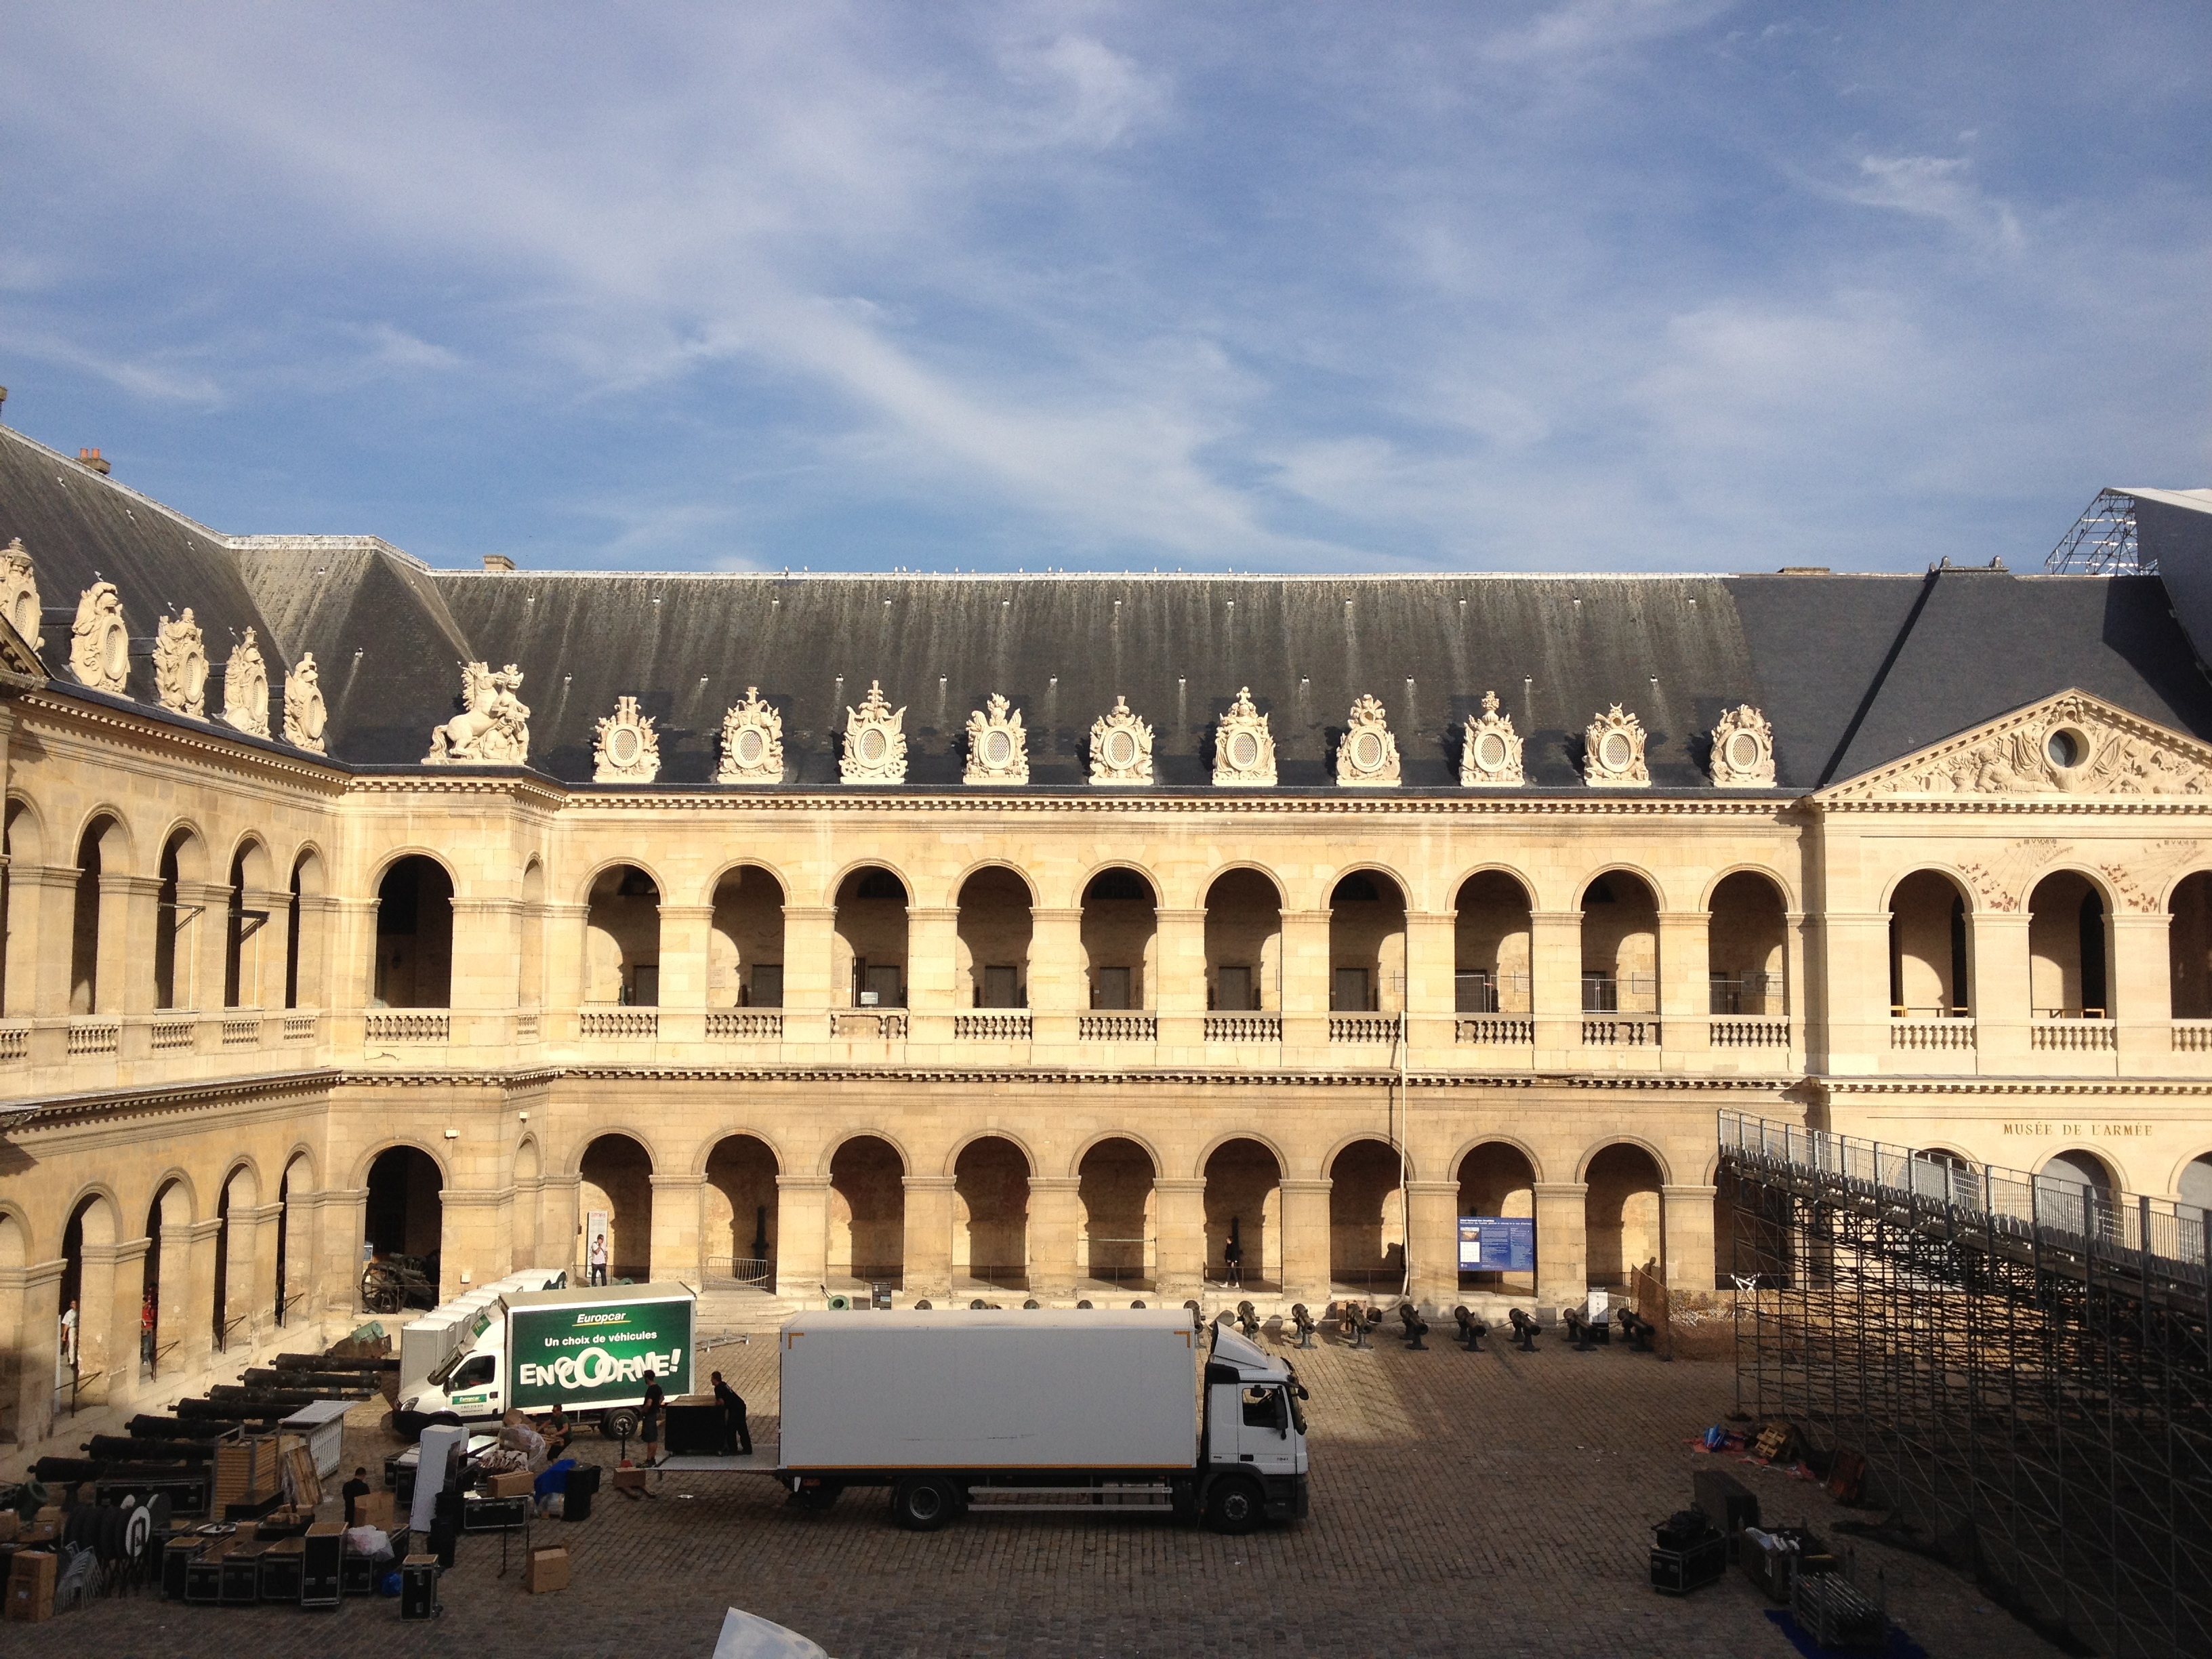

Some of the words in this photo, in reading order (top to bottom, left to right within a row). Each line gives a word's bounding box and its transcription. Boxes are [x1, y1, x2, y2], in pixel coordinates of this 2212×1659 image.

[2003, 1121, 2053, 1135] MUSÉE
[2062, 1124, 2081, 1136] DE
[2091, 1122, 2152, 1136] L'ARMÉE
[577, 1312, 626, 1325] Europcar
[544, 1337, 560, 1347] Un
[562, 1336, 590, 1345] choix
[592, 1334, 606, 1344] de
[608, 1330, 657, 1343] véhicules
